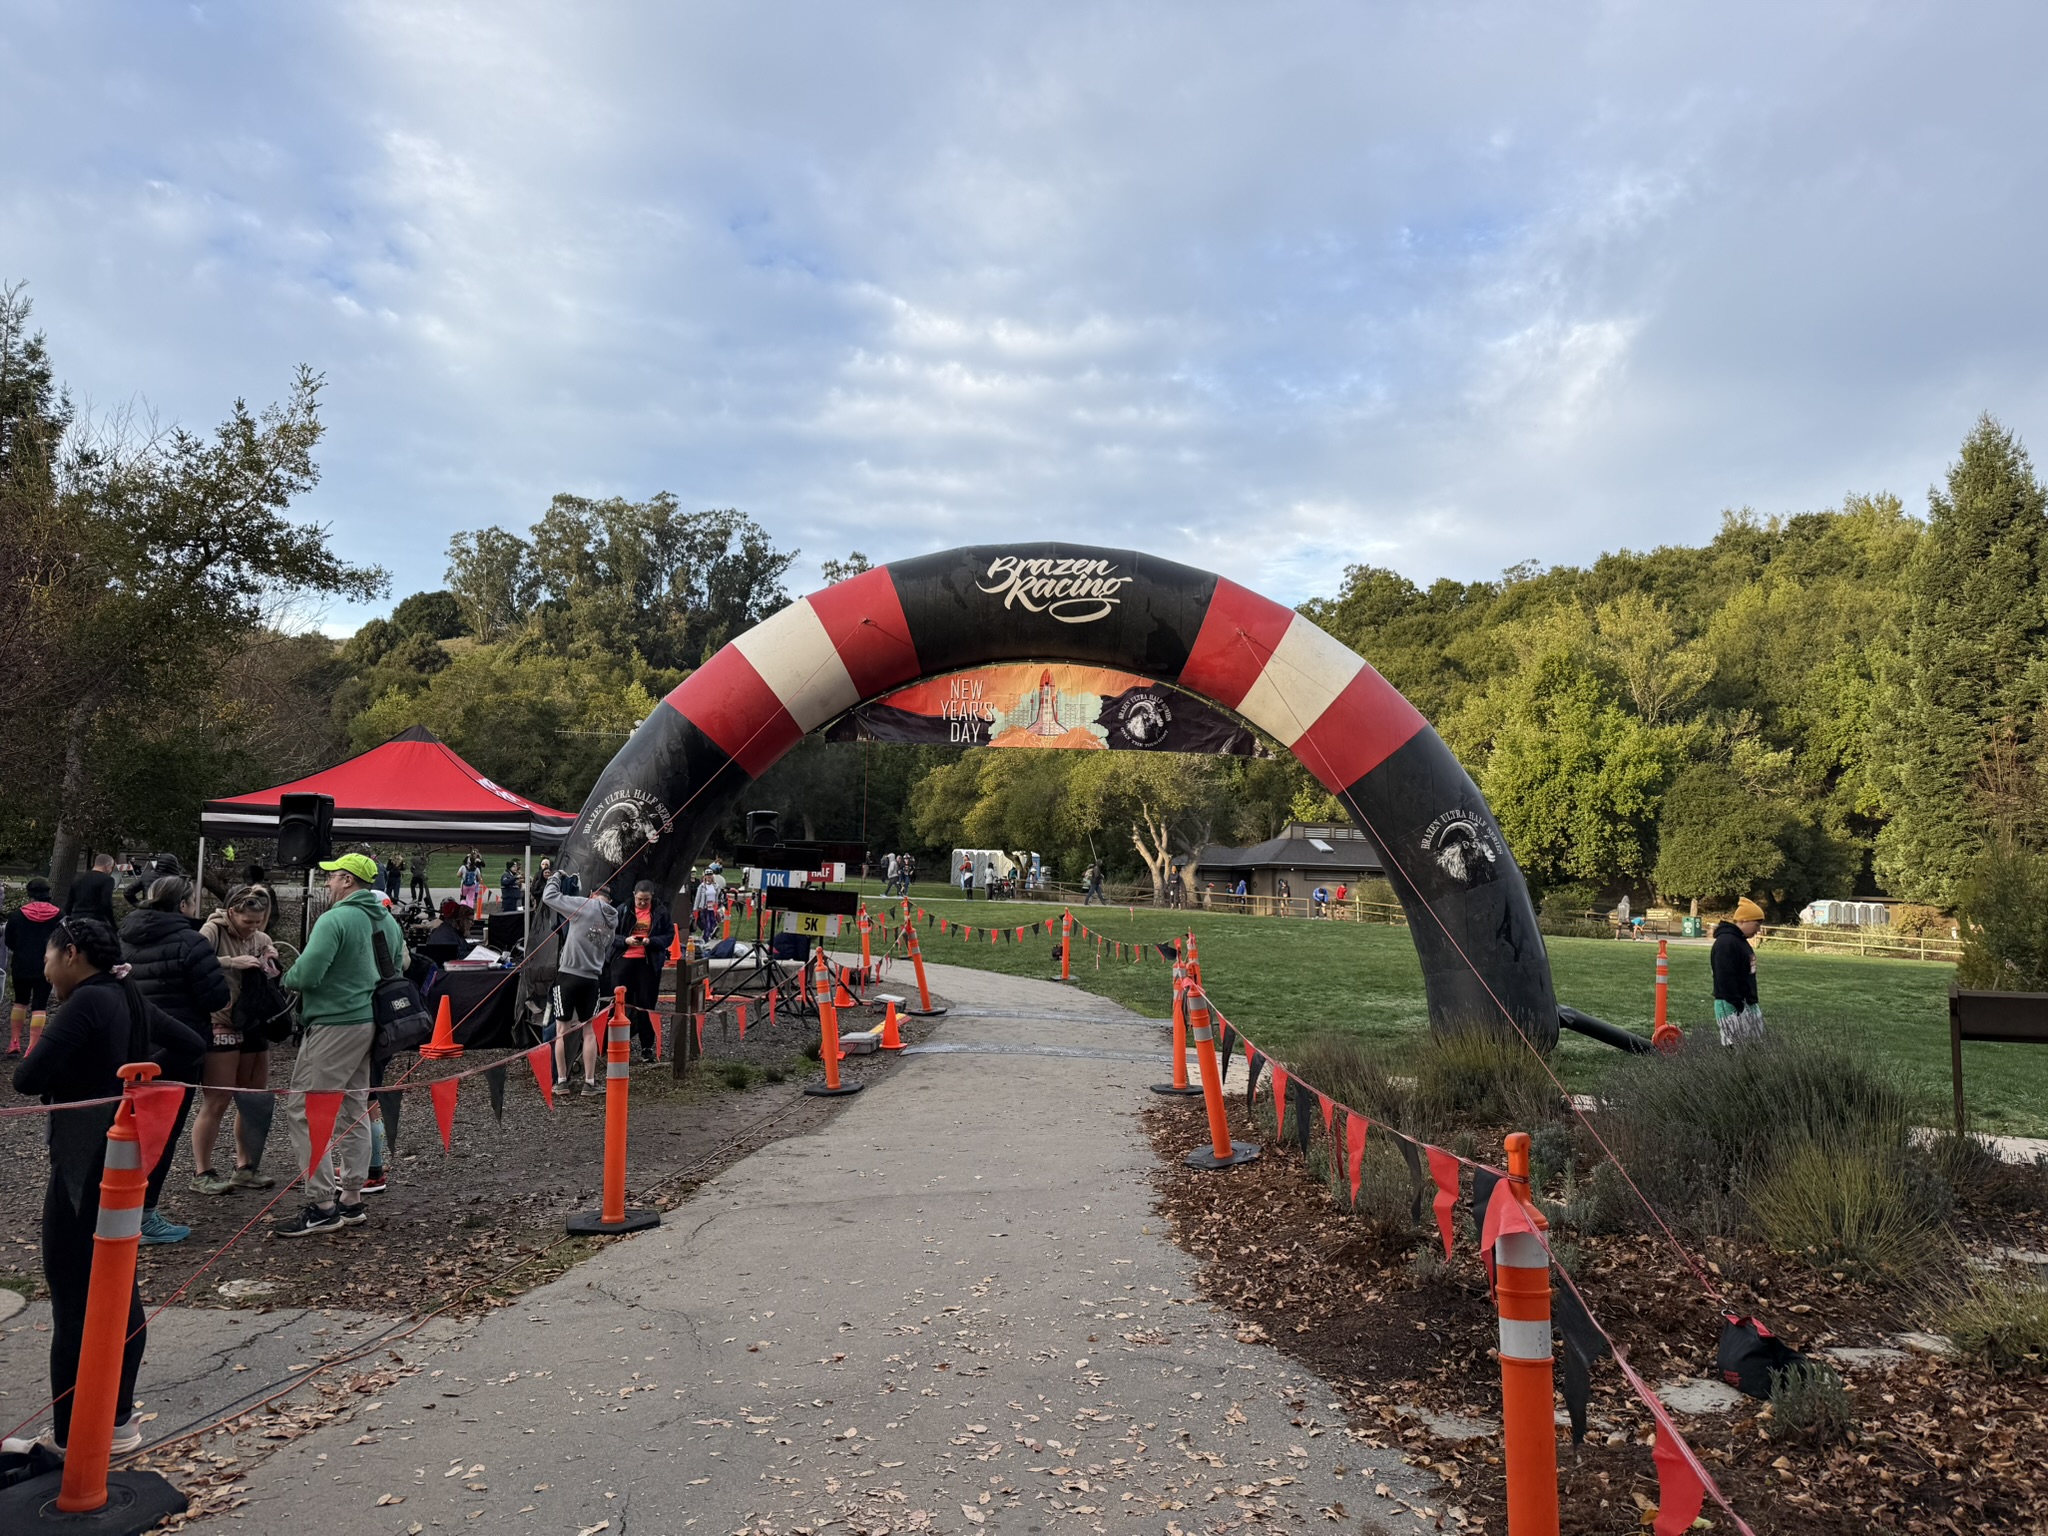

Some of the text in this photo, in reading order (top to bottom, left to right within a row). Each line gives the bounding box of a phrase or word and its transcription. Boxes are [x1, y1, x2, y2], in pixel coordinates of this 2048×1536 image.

[975, 556, 1119, 594] Brazen
[1004, 573, 1133, 623] Racing
[951, 678, 984, 700] NEW
[940, 699, 994, 722] YEAR'S
[950, 722, 981, 743] DAY
[583, 802, 605, 834] BRAZEN
[604, 789, 630, 805] ULTRA
[633, 788, 658, 806] HALF
[1420, 818, 1442, 850] BRAZEN
[1440, 809, 1467, 824] ULTRA
[1468, 811, 1488, 827] HALF
[766, 872, 785, 887] 10K
[804, 917, 818, 932] 5K
